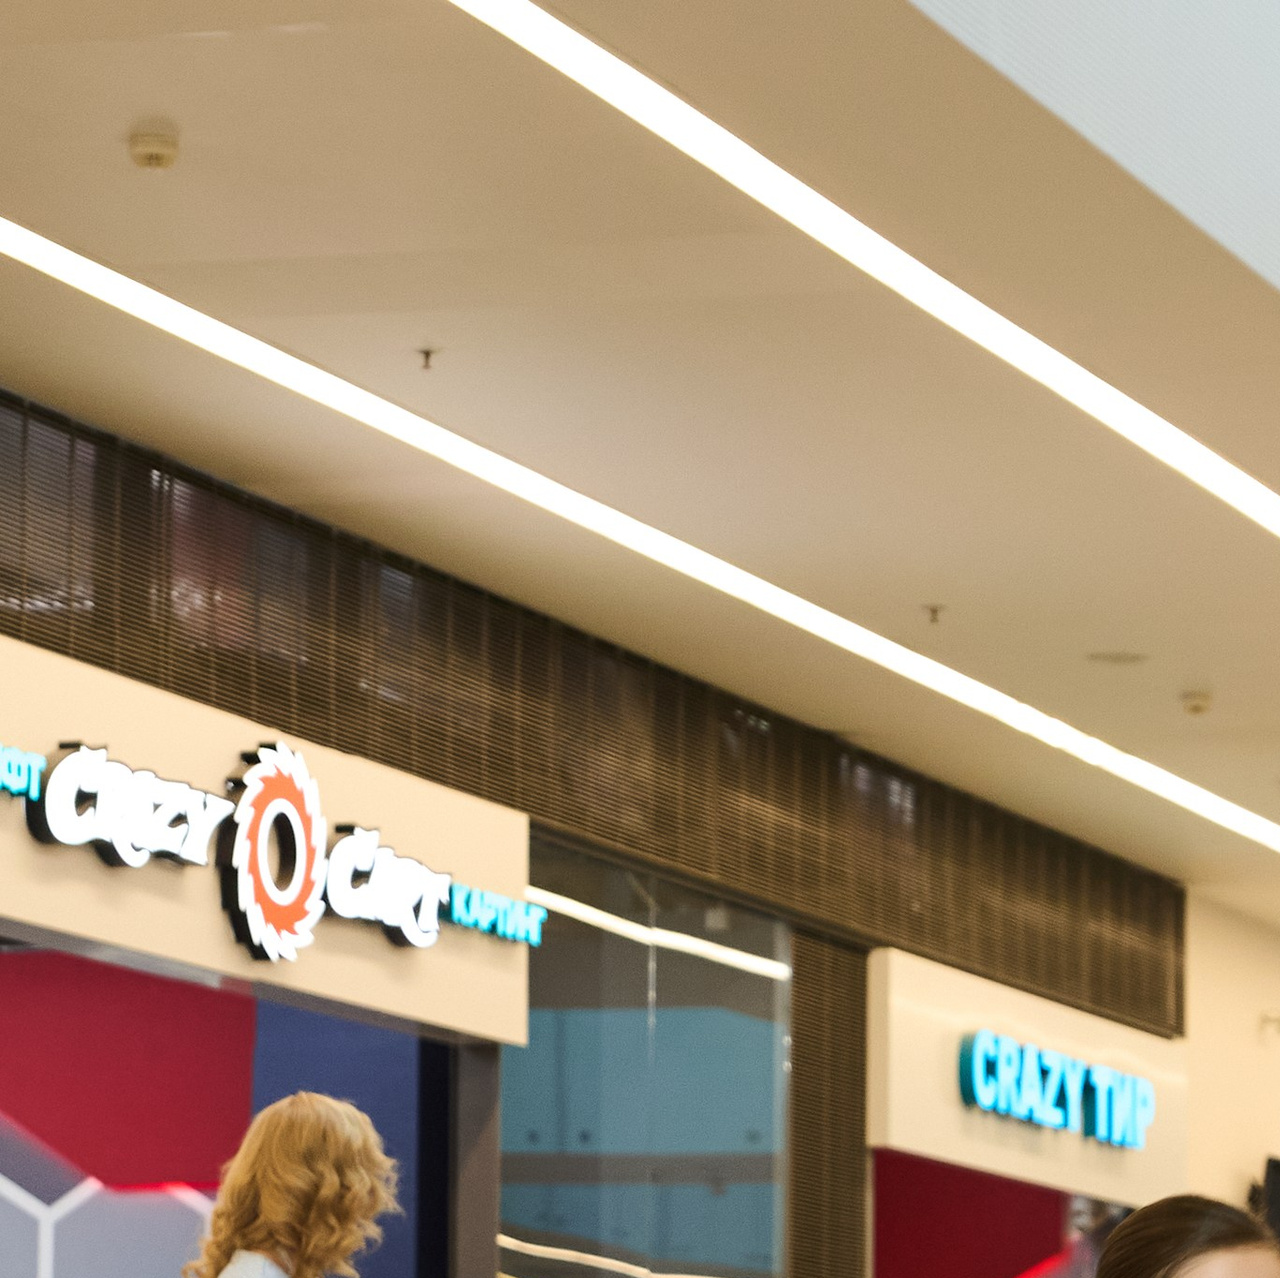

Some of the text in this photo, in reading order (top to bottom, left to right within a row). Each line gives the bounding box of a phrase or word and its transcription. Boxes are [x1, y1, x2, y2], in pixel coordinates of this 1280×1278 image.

[0, 742, 47, 802] ФТ
[968, 1027, 1156, 1152] CRAZY ТИР
